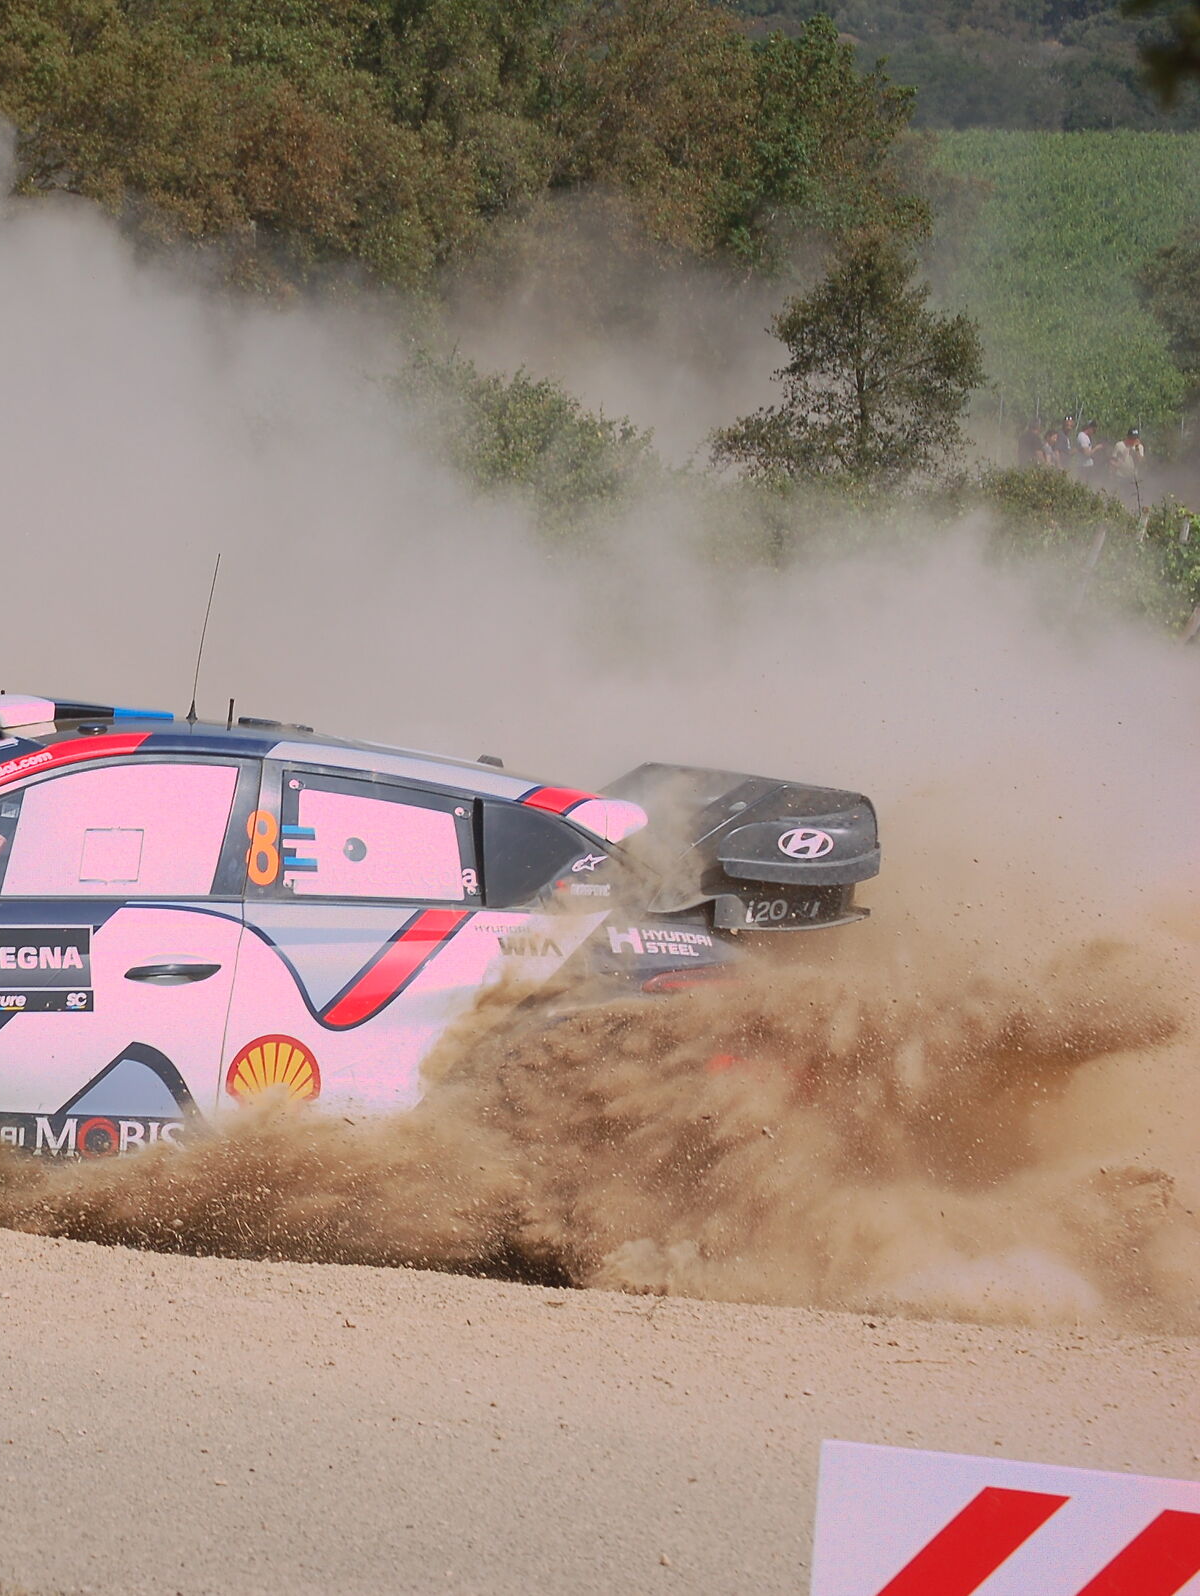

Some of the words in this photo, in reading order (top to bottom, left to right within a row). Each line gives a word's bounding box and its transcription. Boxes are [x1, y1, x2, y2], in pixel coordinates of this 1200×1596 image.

[246, 809, 280, 887] 8
[642, 928, 713, 948] HYUNDAI
[646, 941, 700, 957] STEEL
[65, 992, 88, 1007] SC
[32, 1116, 186, 1160] MOBIS
